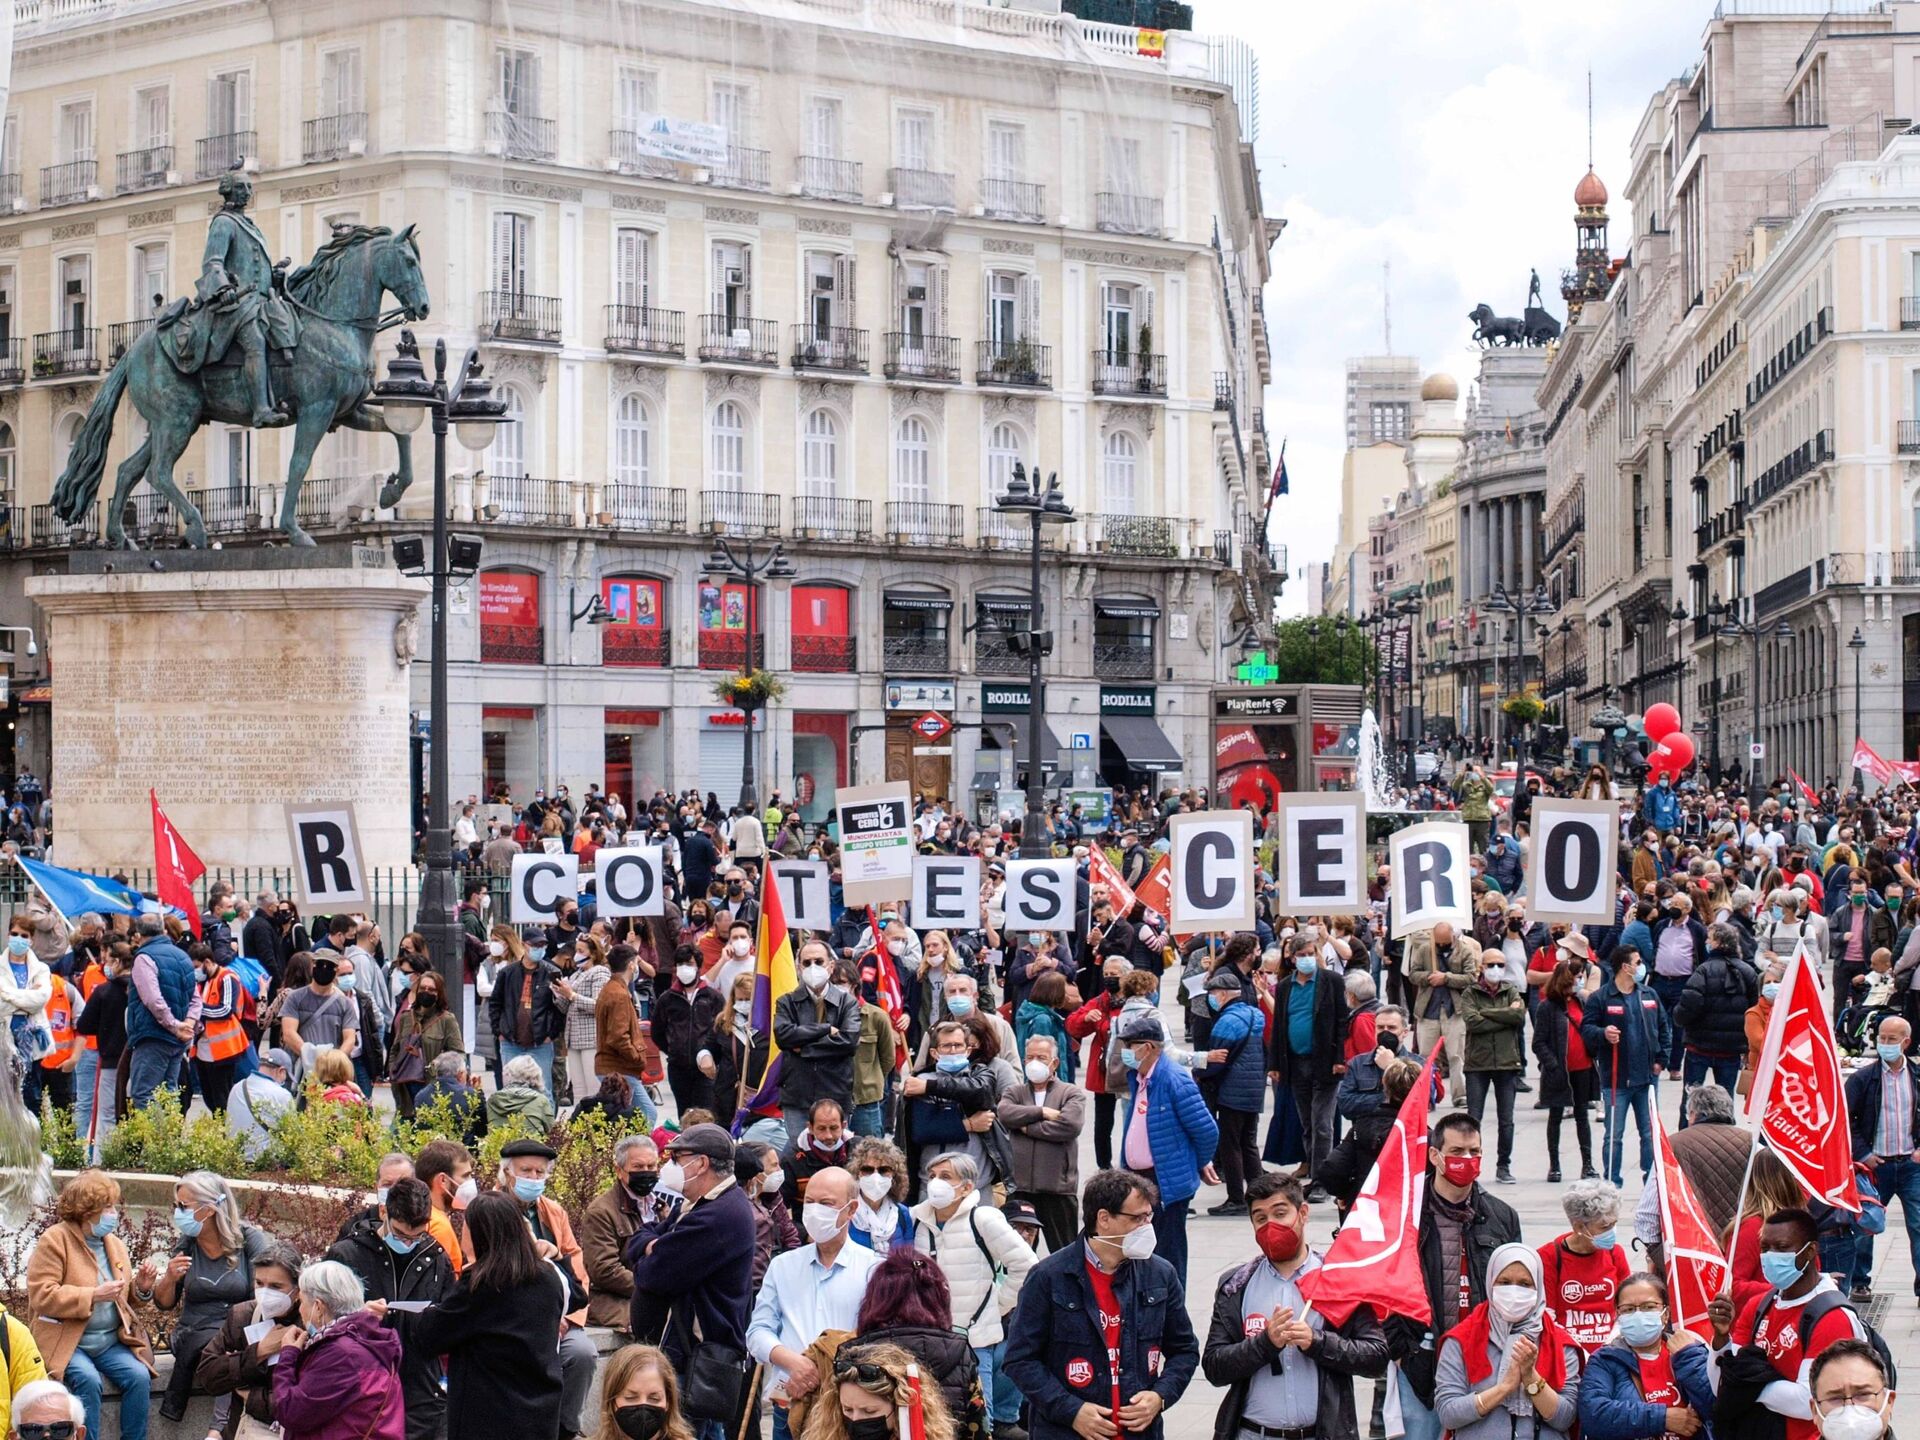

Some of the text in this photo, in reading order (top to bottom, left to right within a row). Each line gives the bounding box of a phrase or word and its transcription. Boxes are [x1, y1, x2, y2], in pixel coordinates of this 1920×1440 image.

[1248, 667, 1268, 678] 12H
[986, 692, 1032, 704] RODILL
[1102, 694, 1152, 706] RODILLA
[1227, 698, 1271, 711] PlayRenfe
[847, 830, 902, 842] MUNICIPALISTAS
[858, 818, 879, 830] CERO
[299, 821, 356, 894] R
[852, 838, 898, 850] GRUPO VERDE
[1298, 819, 1347, 897] E
[1185, 831, 1237, 910] C
[1402, 840, 1457, 913] R
[1544, 820, 1602, 902] O
[522, 861, 567, 915] C
[604, 855, 652, 908] O
[776, 868, 823, 921] T
[926, 866, 966, 919] E
[1020, 867, 1062, 921] S
[1764, 1101, 1816, 1155] Madrid
[1584, 1284, 1607, 1292] FeSMC
[1246, 1318, 1266, 1330] UGT
[1069, 1362, 1089, 1374] UGT
[1645, 1388, 1671, 1401] FeSMC
